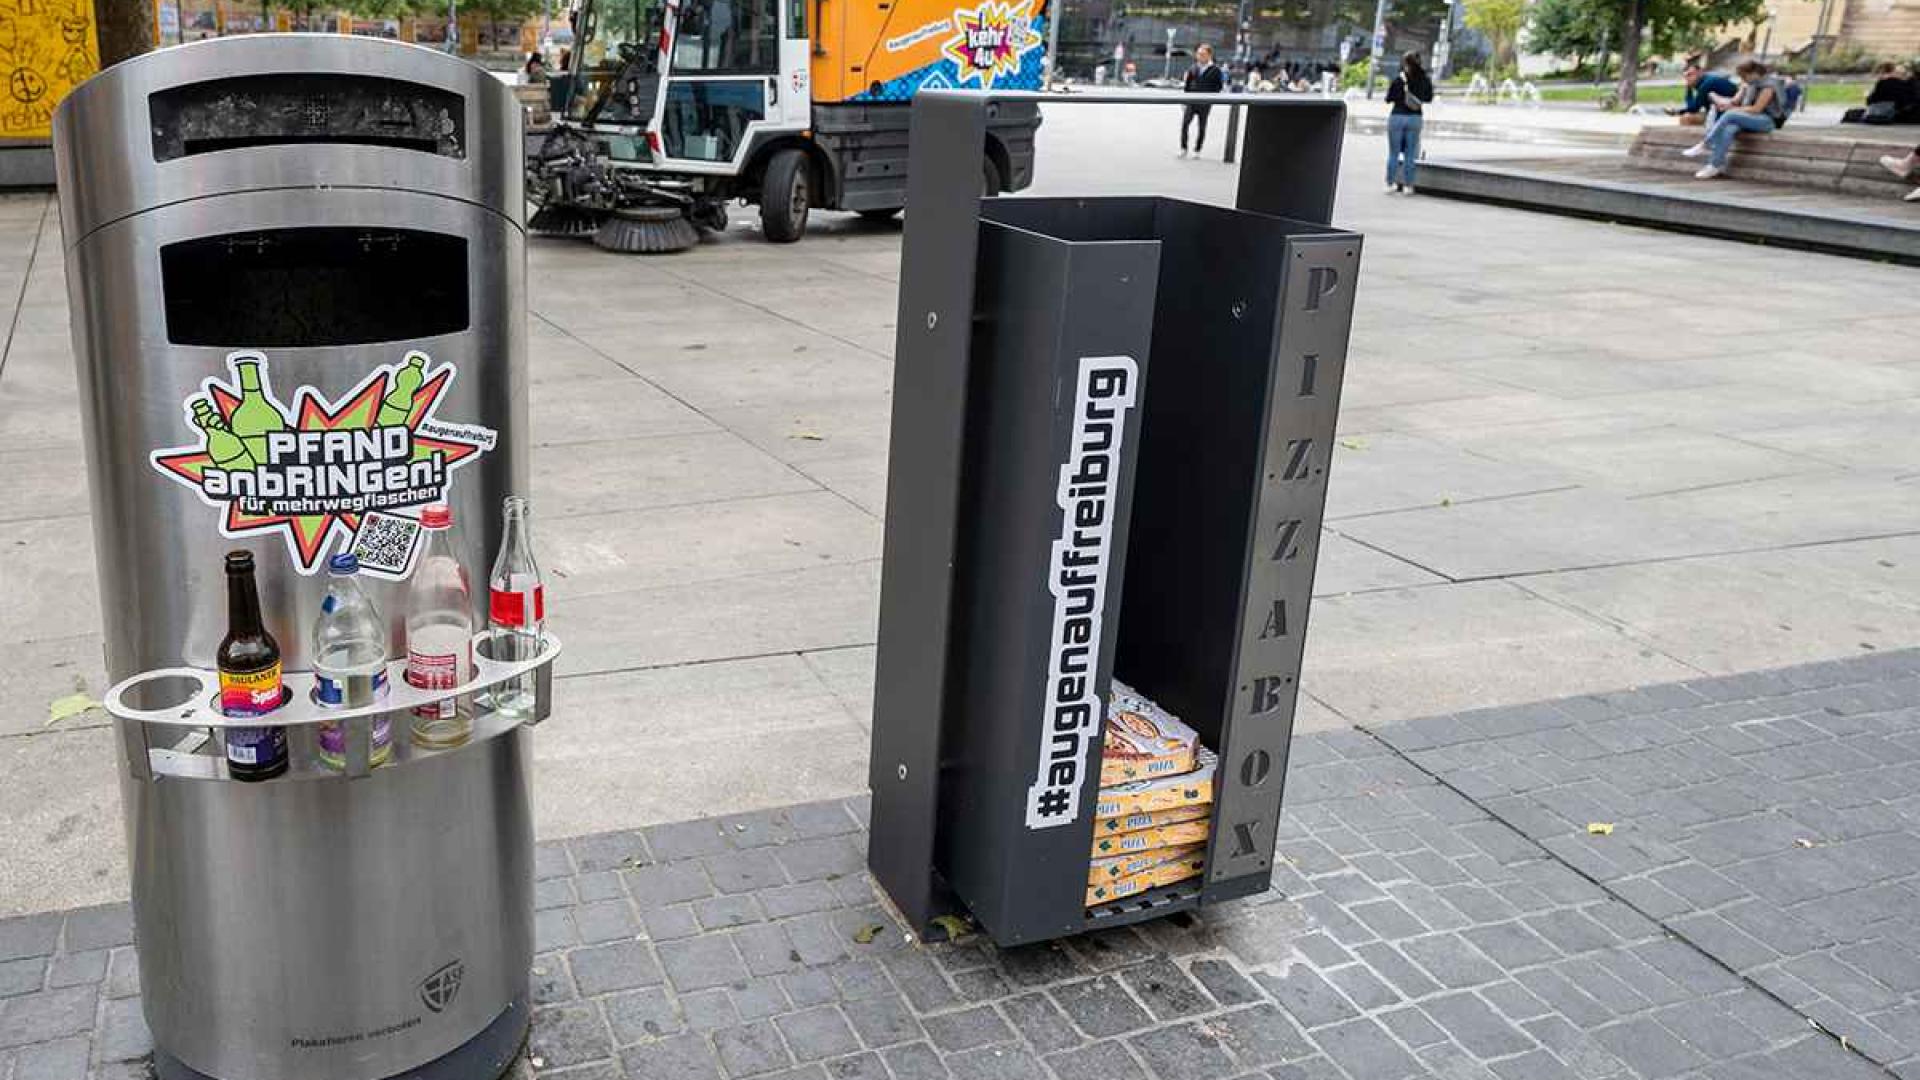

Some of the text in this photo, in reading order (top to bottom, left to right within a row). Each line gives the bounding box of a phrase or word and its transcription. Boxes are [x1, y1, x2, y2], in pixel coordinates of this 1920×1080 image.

[968, 27, 1004, 49] kehr
[268, 427, 409, 465] PFAND
[204, 451, 444, 497] anbRINGen!
[239, 487, 438, 513] für mehrwegflaschen
[1037, 368, 1127, 818] #augenauffreiburg
